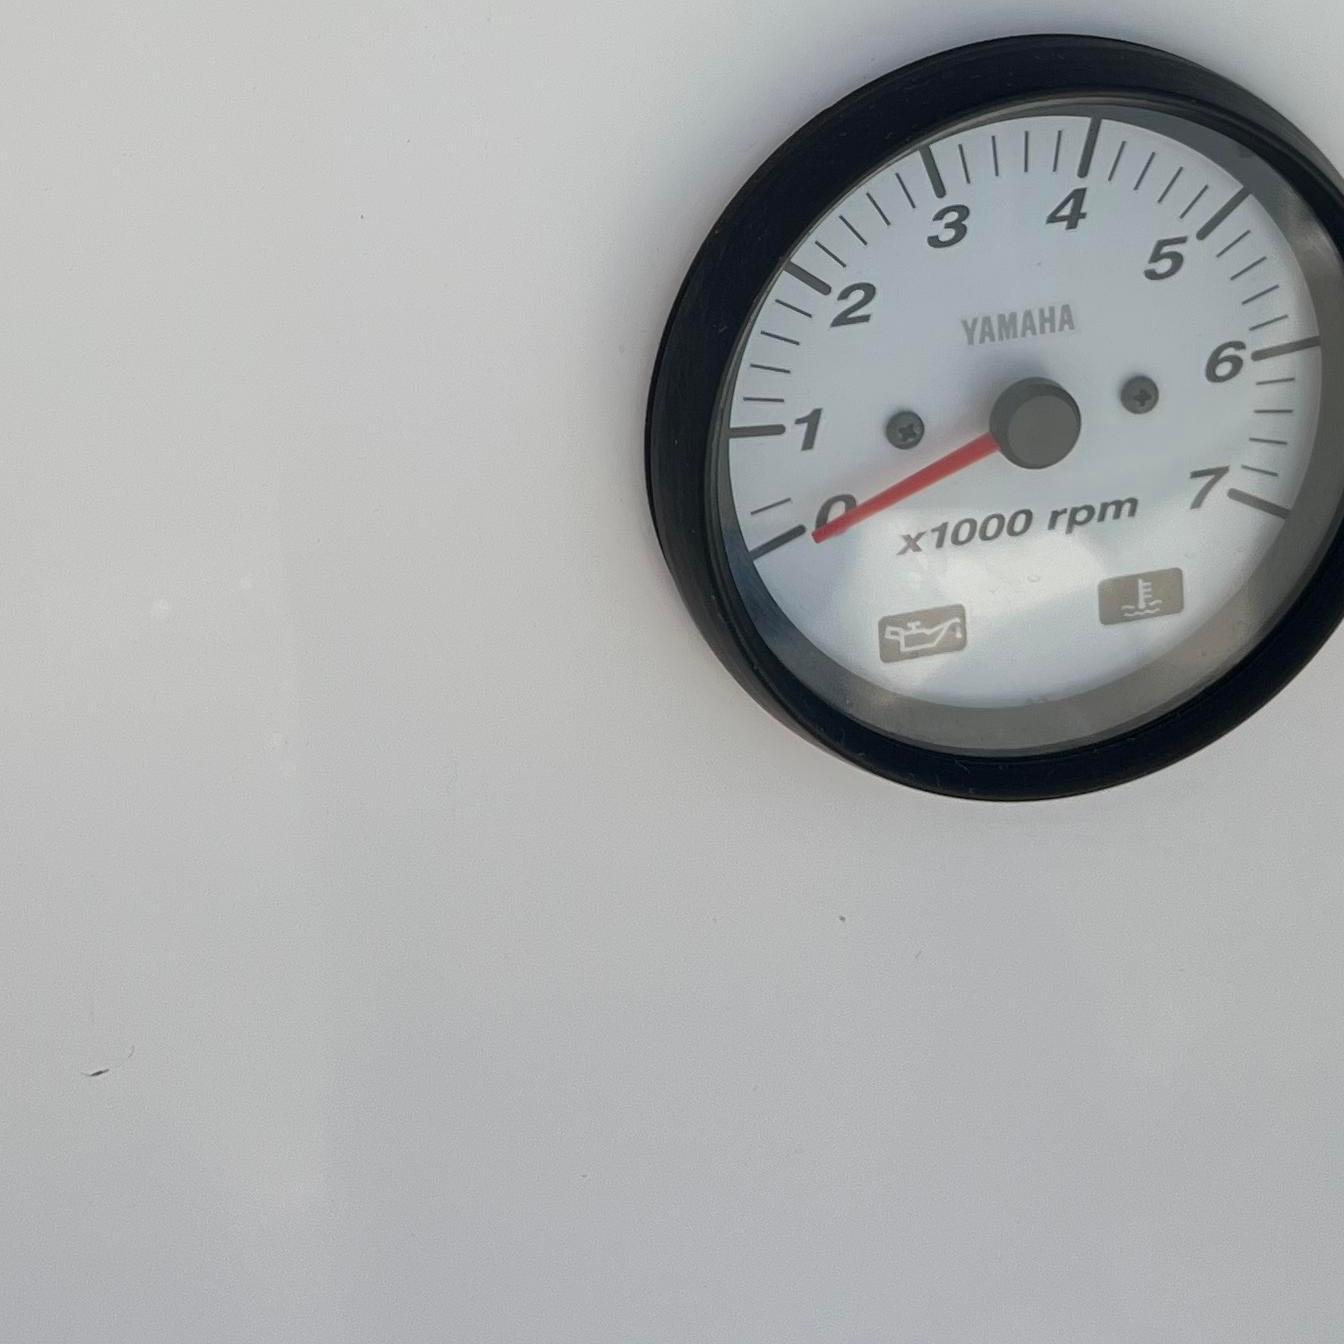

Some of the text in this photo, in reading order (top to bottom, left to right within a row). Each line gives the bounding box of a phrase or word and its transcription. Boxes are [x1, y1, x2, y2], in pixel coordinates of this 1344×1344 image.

[926, 204, 971, 249] 3
[1046, 187, 1088, 231] 4
[1143, 236, 1188, 282] 5
[830, 282, 877, 328] 2
[961, 303, 1076, 346] YAMAHA
[1204, 341, 1247, 384] 6
[793, 408, 824, 452] 1
[1188, 466, 1231, 510] 7
[896, 496, 1140, 556] x1000 rpm
